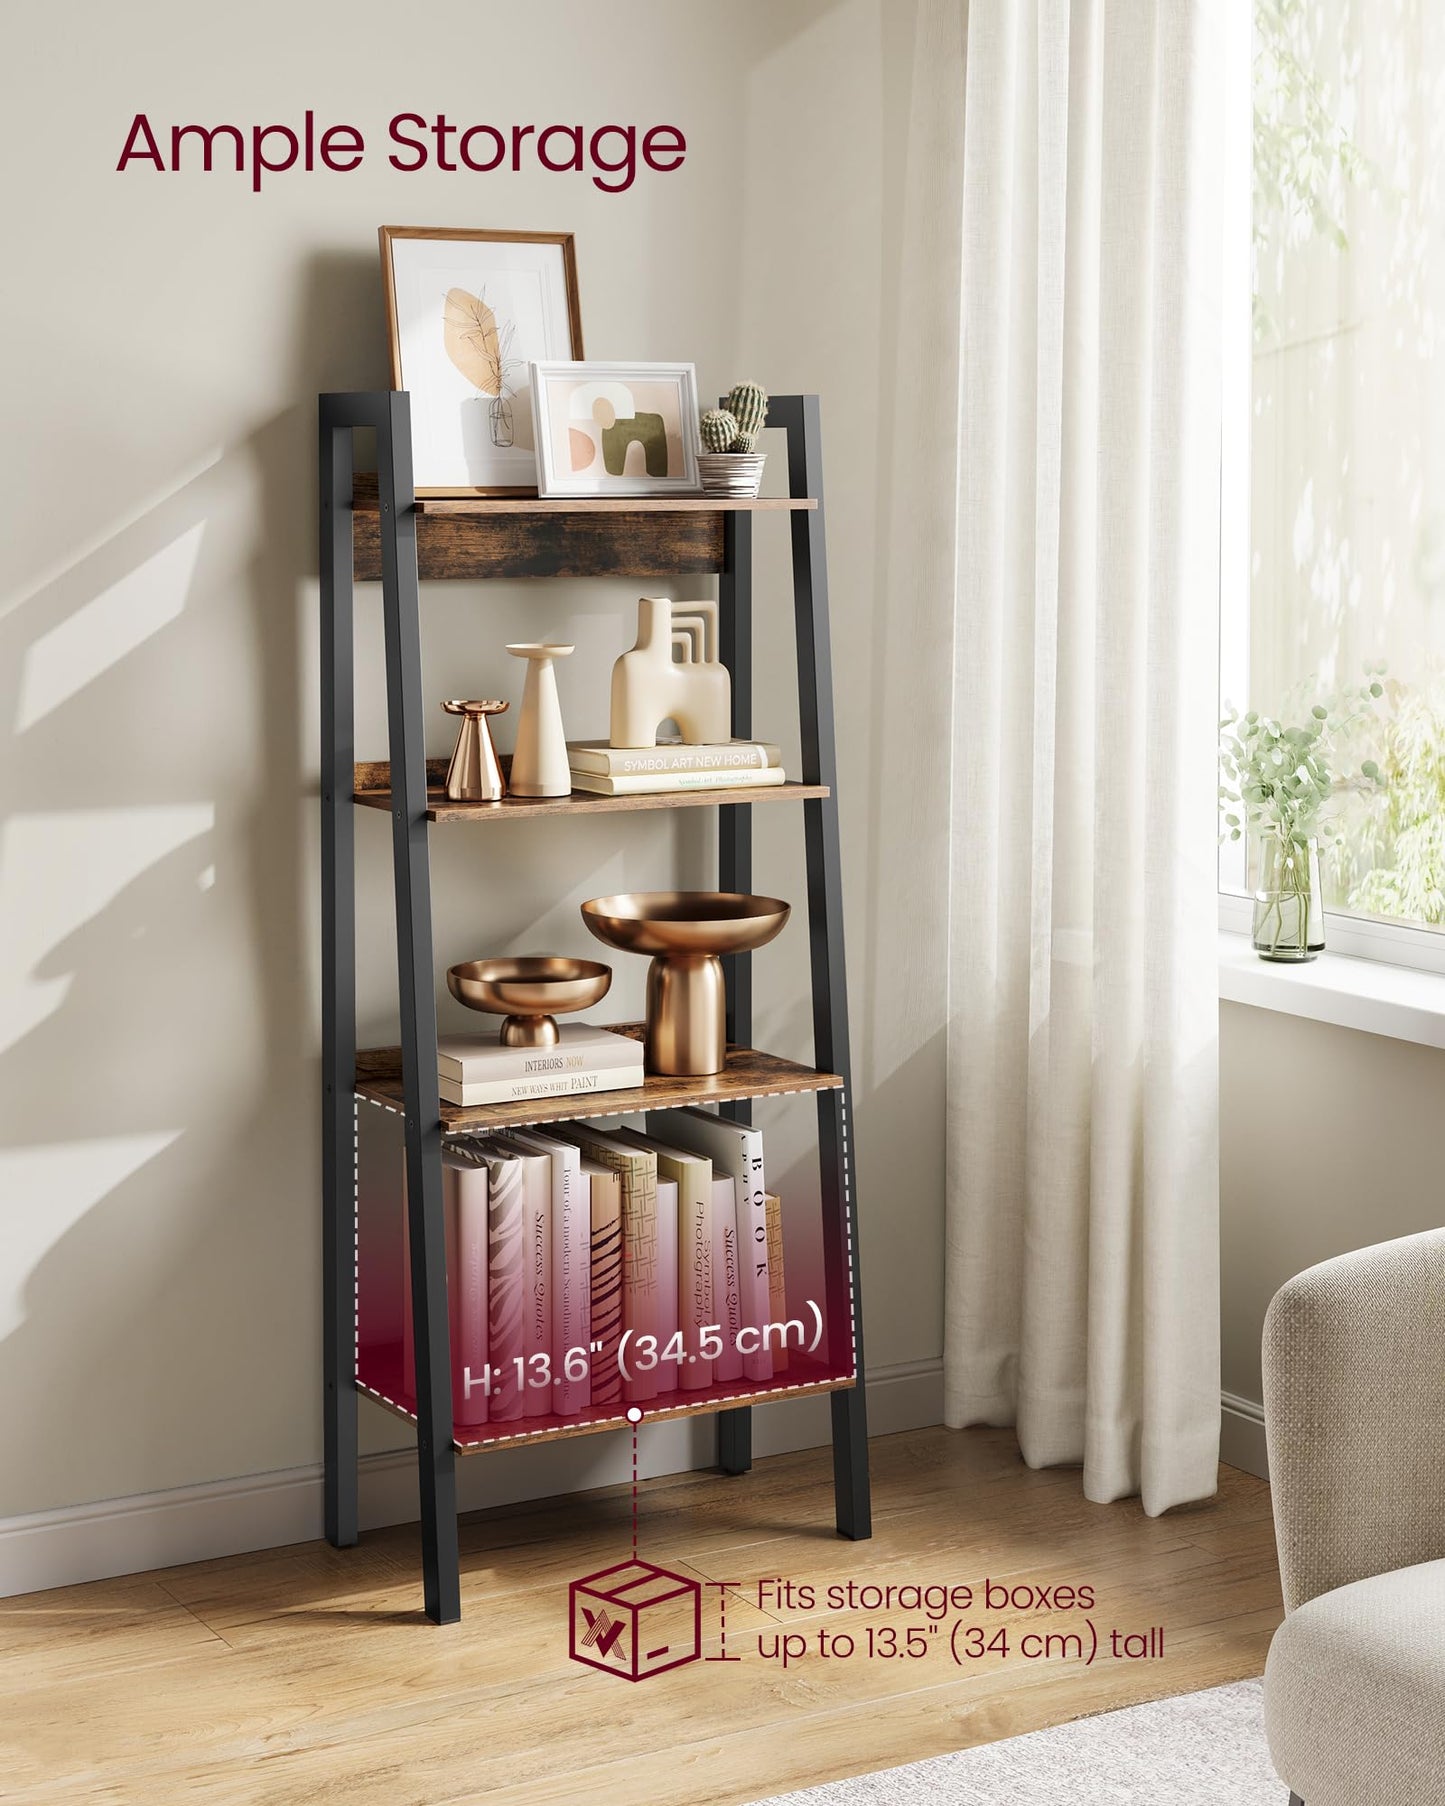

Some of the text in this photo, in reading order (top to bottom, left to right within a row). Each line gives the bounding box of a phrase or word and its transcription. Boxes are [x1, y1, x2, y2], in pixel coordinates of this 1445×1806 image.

[624, 752, 758, 772] SYMBOL ART NEW HOME
[511, 1086, 528, 1097] NEW
[529, 1084, 549, 1096] WAYS
[570, 1075, 599, 1090] PAINT
[525, 1056, 584, 1072] INTERIORS NOW
[563, 1168, 572, 1197] Tour
[563, 1199, 572, 1213] of
[534, 1210, 545, 1342] Success Quotes
[563, 1225, 572, 1276] modern
[693, 1200, 705, 1329] Photography
[702, 1239, 711, 1315] Symbol
[724, 1226, 739, 1346] Success Quotes
[563, 1278, 571, 1359] Scandinavia
